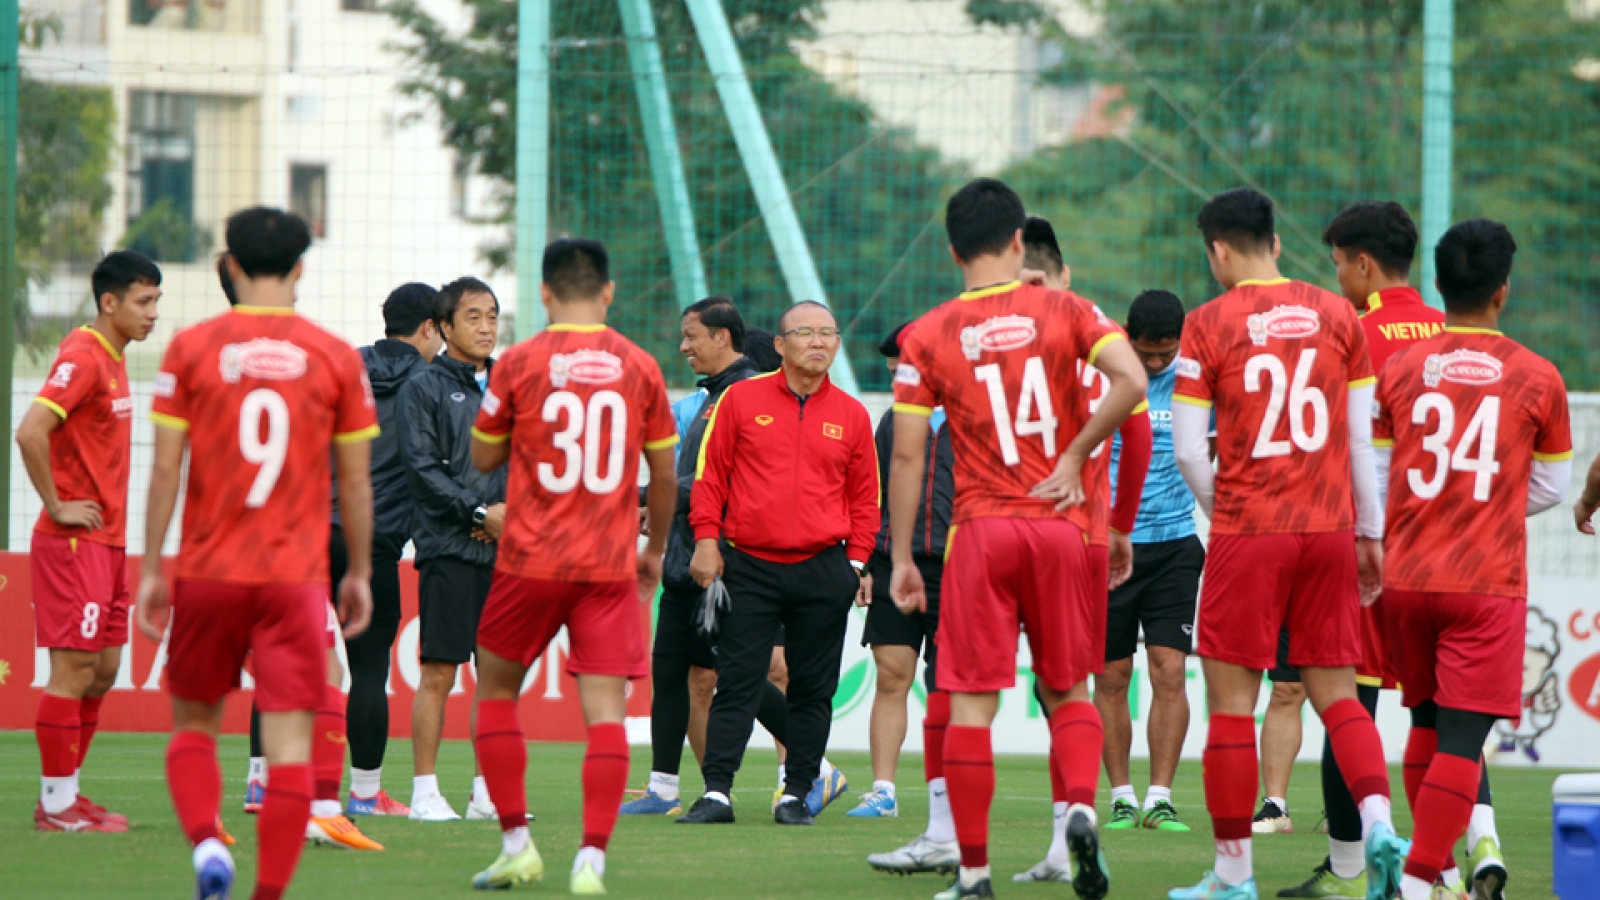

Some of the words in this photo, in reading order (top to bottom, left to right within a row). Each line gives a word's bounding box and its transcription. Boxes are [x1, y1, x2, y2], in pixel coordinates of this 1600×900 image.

[239, 388, 291, 508] 9
[537, 390, 628, 494] 30
[974, 355, 1059, 467] 14
[1244, 348, 1330, 458] 26
[1407, 392, 1500, 502] 34
[80, 602, 99, 638] 8
